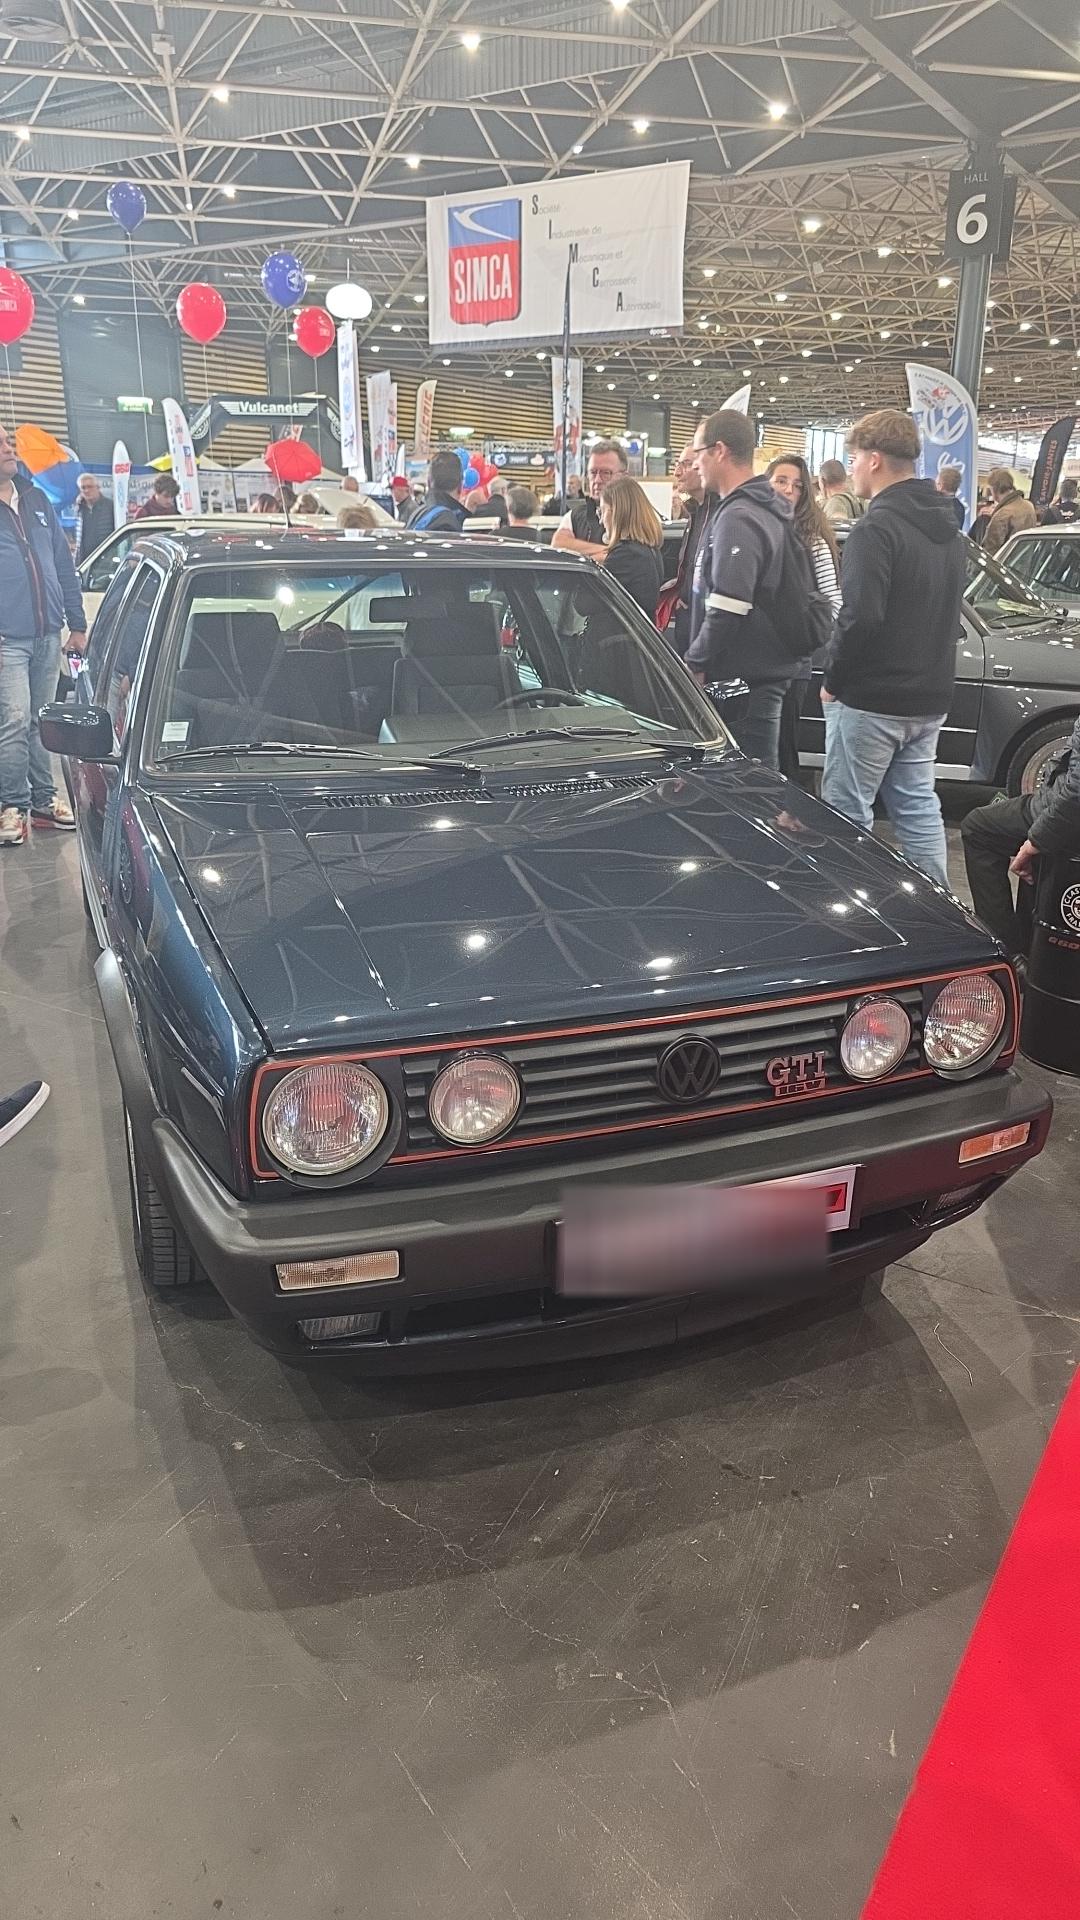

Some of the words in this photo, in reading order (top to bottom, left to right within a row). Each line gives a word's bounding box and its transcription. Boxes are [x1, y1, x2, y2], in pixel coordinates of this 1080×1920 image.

[964, 172, 989, 184] HALL
[956, 194, 988, 245] 6
[454, 254, 513, 305] SIMCA
[239, 401, 299, 413] Vulcanet
[766, 1050, 825, 1086] GTI
[774, 1077, 826, 1097] 16V
